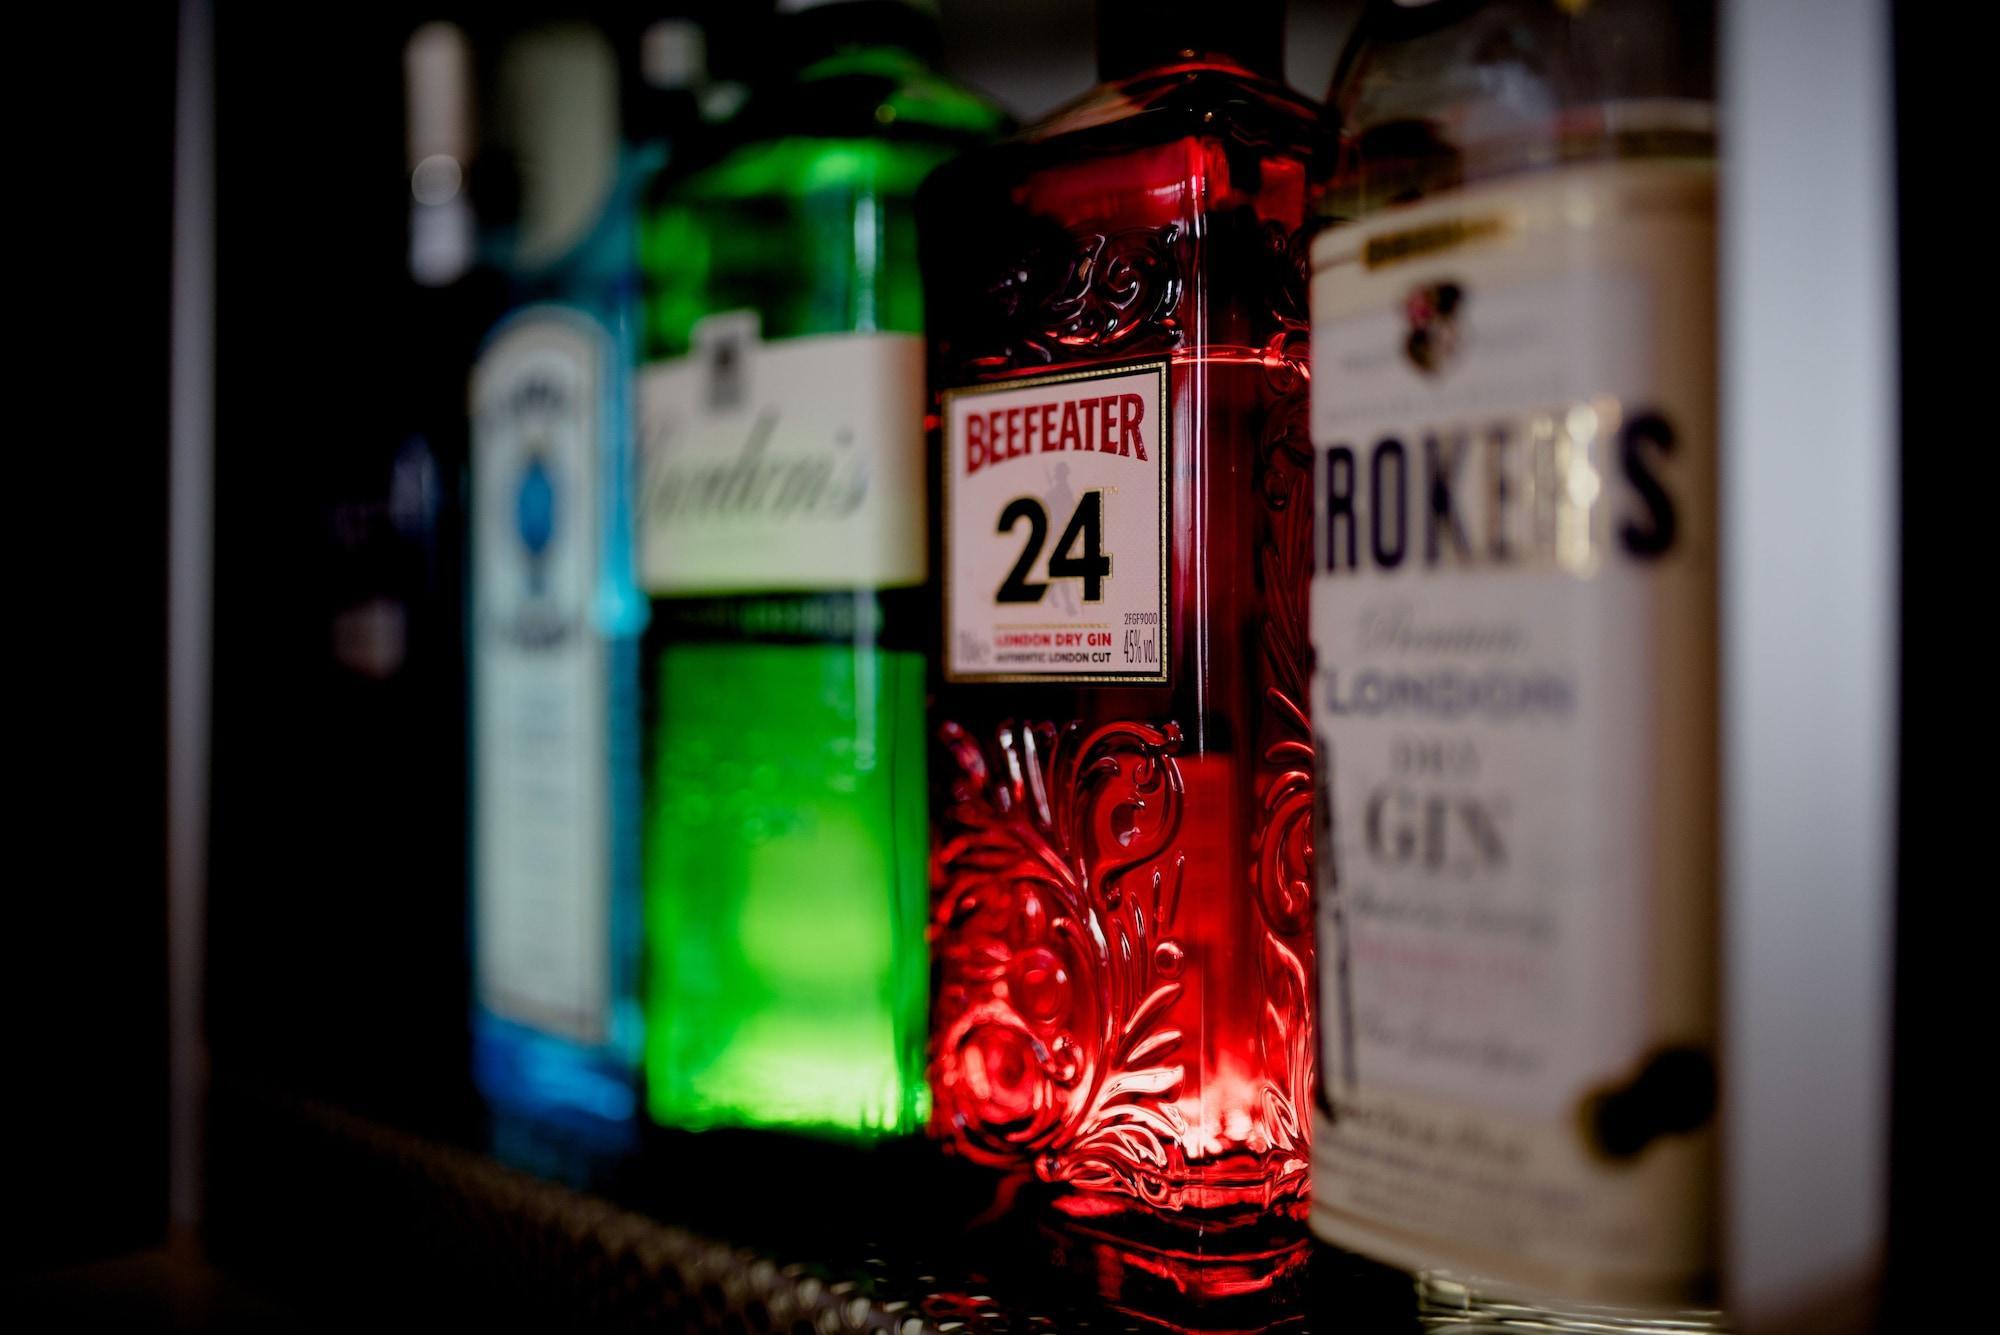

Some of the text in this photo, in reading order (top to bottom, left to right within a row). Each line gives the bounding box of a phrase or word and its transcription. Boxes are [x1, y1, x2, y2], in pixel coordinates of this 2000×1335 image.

[965, 392, 1149, 478] BEEFEATER
[995, 490, 1112, 604] 24
[995, 634, 1051, 648] LONDON
[1055, 633, 1082, 647] DRY
[1087, 632, 1112, 647] GIN
[1048, 652, 1091, 664] LONDON
[1091, 651, 1112, 664] CUT
[1123, 628, 1142, 664] 45%
[1364, 784, 1514, 876] GIN
